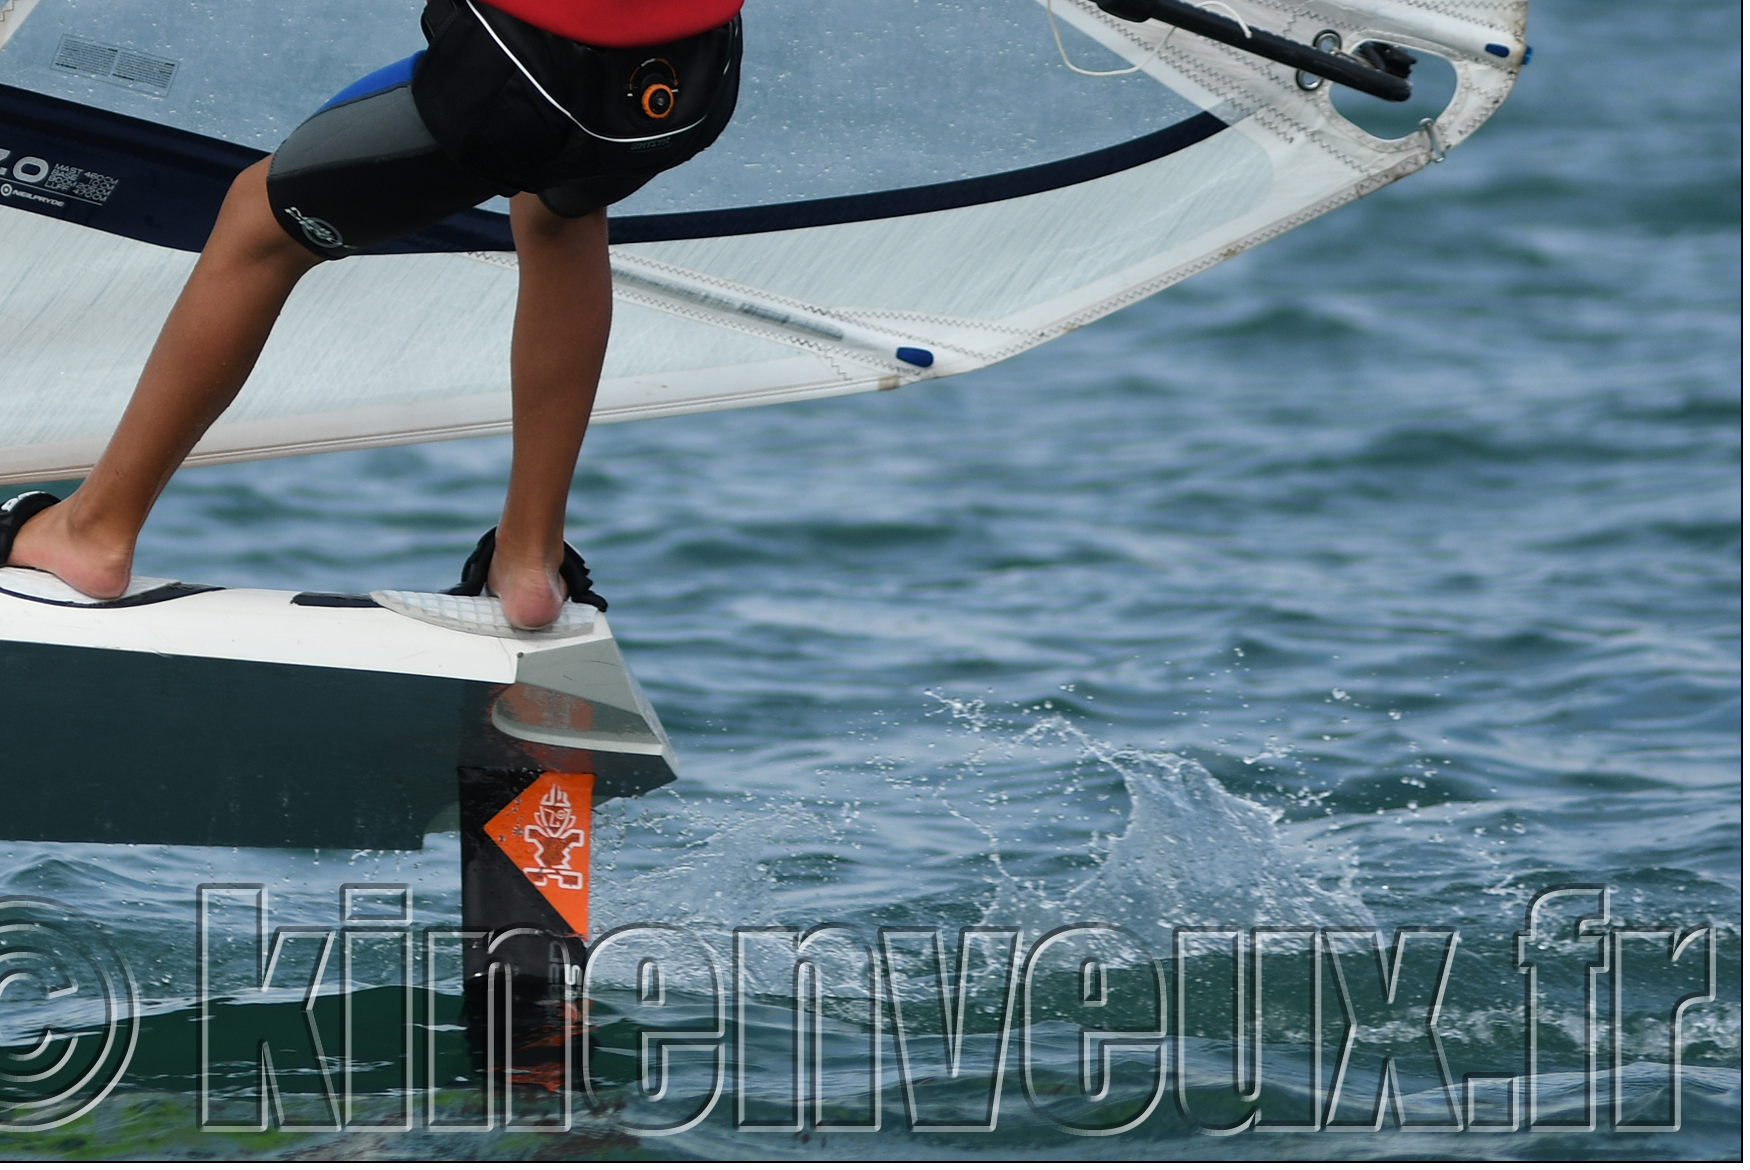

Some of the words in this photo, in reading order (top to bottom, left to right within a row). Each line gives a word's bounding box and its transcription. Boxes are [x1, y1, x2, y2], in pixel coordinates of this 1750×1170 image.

[51, 168, 79, 181] BASE
[53, 163, 84, 175] MAST
[44, 180, 70, 192] LUFF
[48, 174, 78, 187] BOOM
[12, 189, 65, 208] NEILPRYDE
